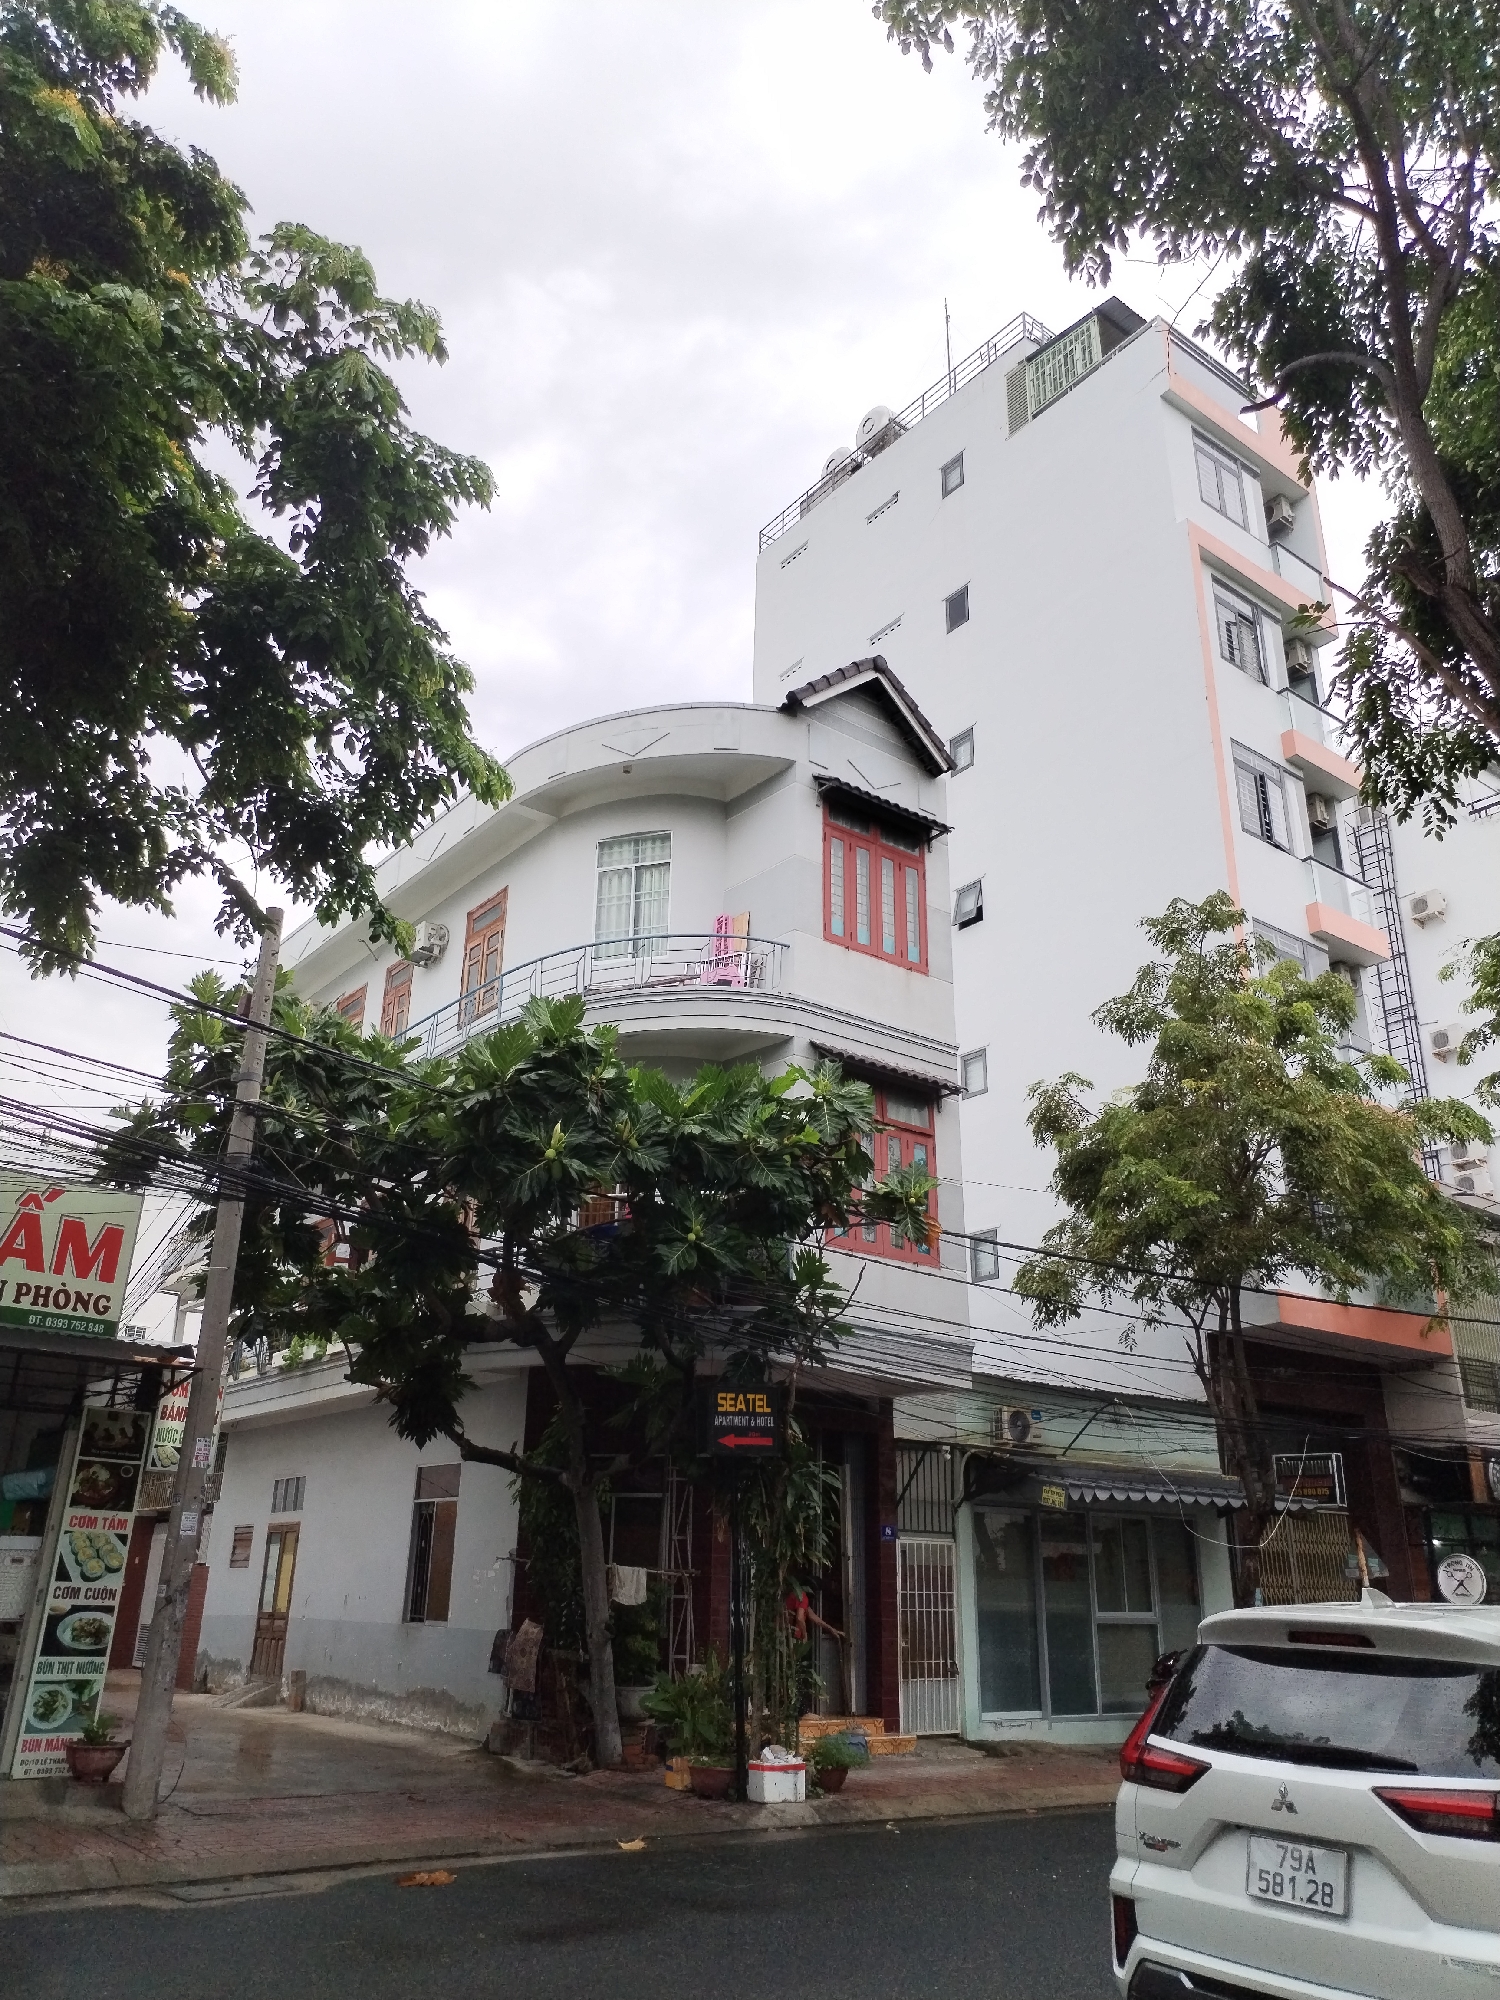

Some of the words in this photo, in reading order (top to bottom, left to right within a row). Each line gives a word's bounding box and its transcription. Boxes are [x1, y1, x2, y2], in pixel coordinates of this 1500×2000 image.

[12, 1281, 112, 1316] PHÒNG
[45, 1317, 69, 1329] 0393
[70, 1320, 87, 1332] 752
[87, 1323, 105, 1334] 848
[717, 1392, 772, 1413] SEATEL
[714, 1415, 750, 1427] APARTMENT
[756, 1416, 775, 1427] HOTEL
[68, 1514, 99, 1529] CƠM
[101, 1513, 129, 1531] TẤM
[52, 1585, 82, 1600] CƠM
[83, 1585, 118, 1604] CUỘN
[35, 1657, 56, 1675] BÚN
[56, 1660, 76, 1678] THỊT
[1275, 1843, 1317, 1876] 79A
[1257, 1868, 1335, 1909] 581.28
